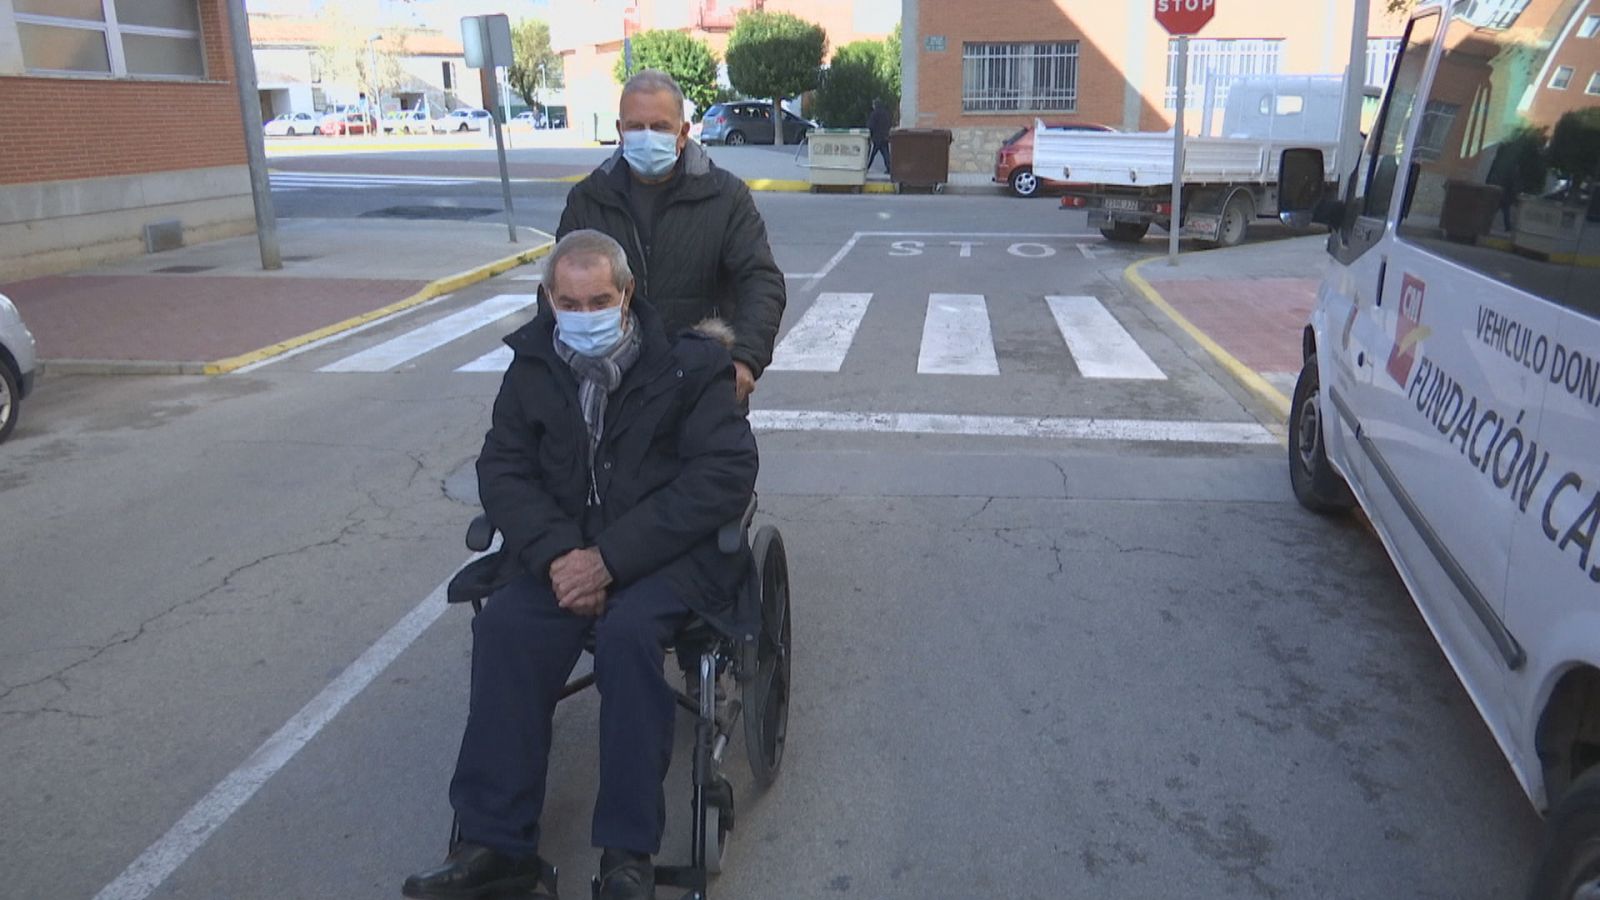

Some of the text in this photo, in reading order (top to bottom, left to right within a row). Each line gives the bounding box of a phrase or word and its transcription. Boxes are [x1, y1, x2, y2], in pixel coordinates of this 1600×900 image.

[1157, 0, 1213, 13] STOP
[1476, 304, 1600, 408] VEHICULO DON
[1408, 354, 1550, 514] FUNDACIÓN
